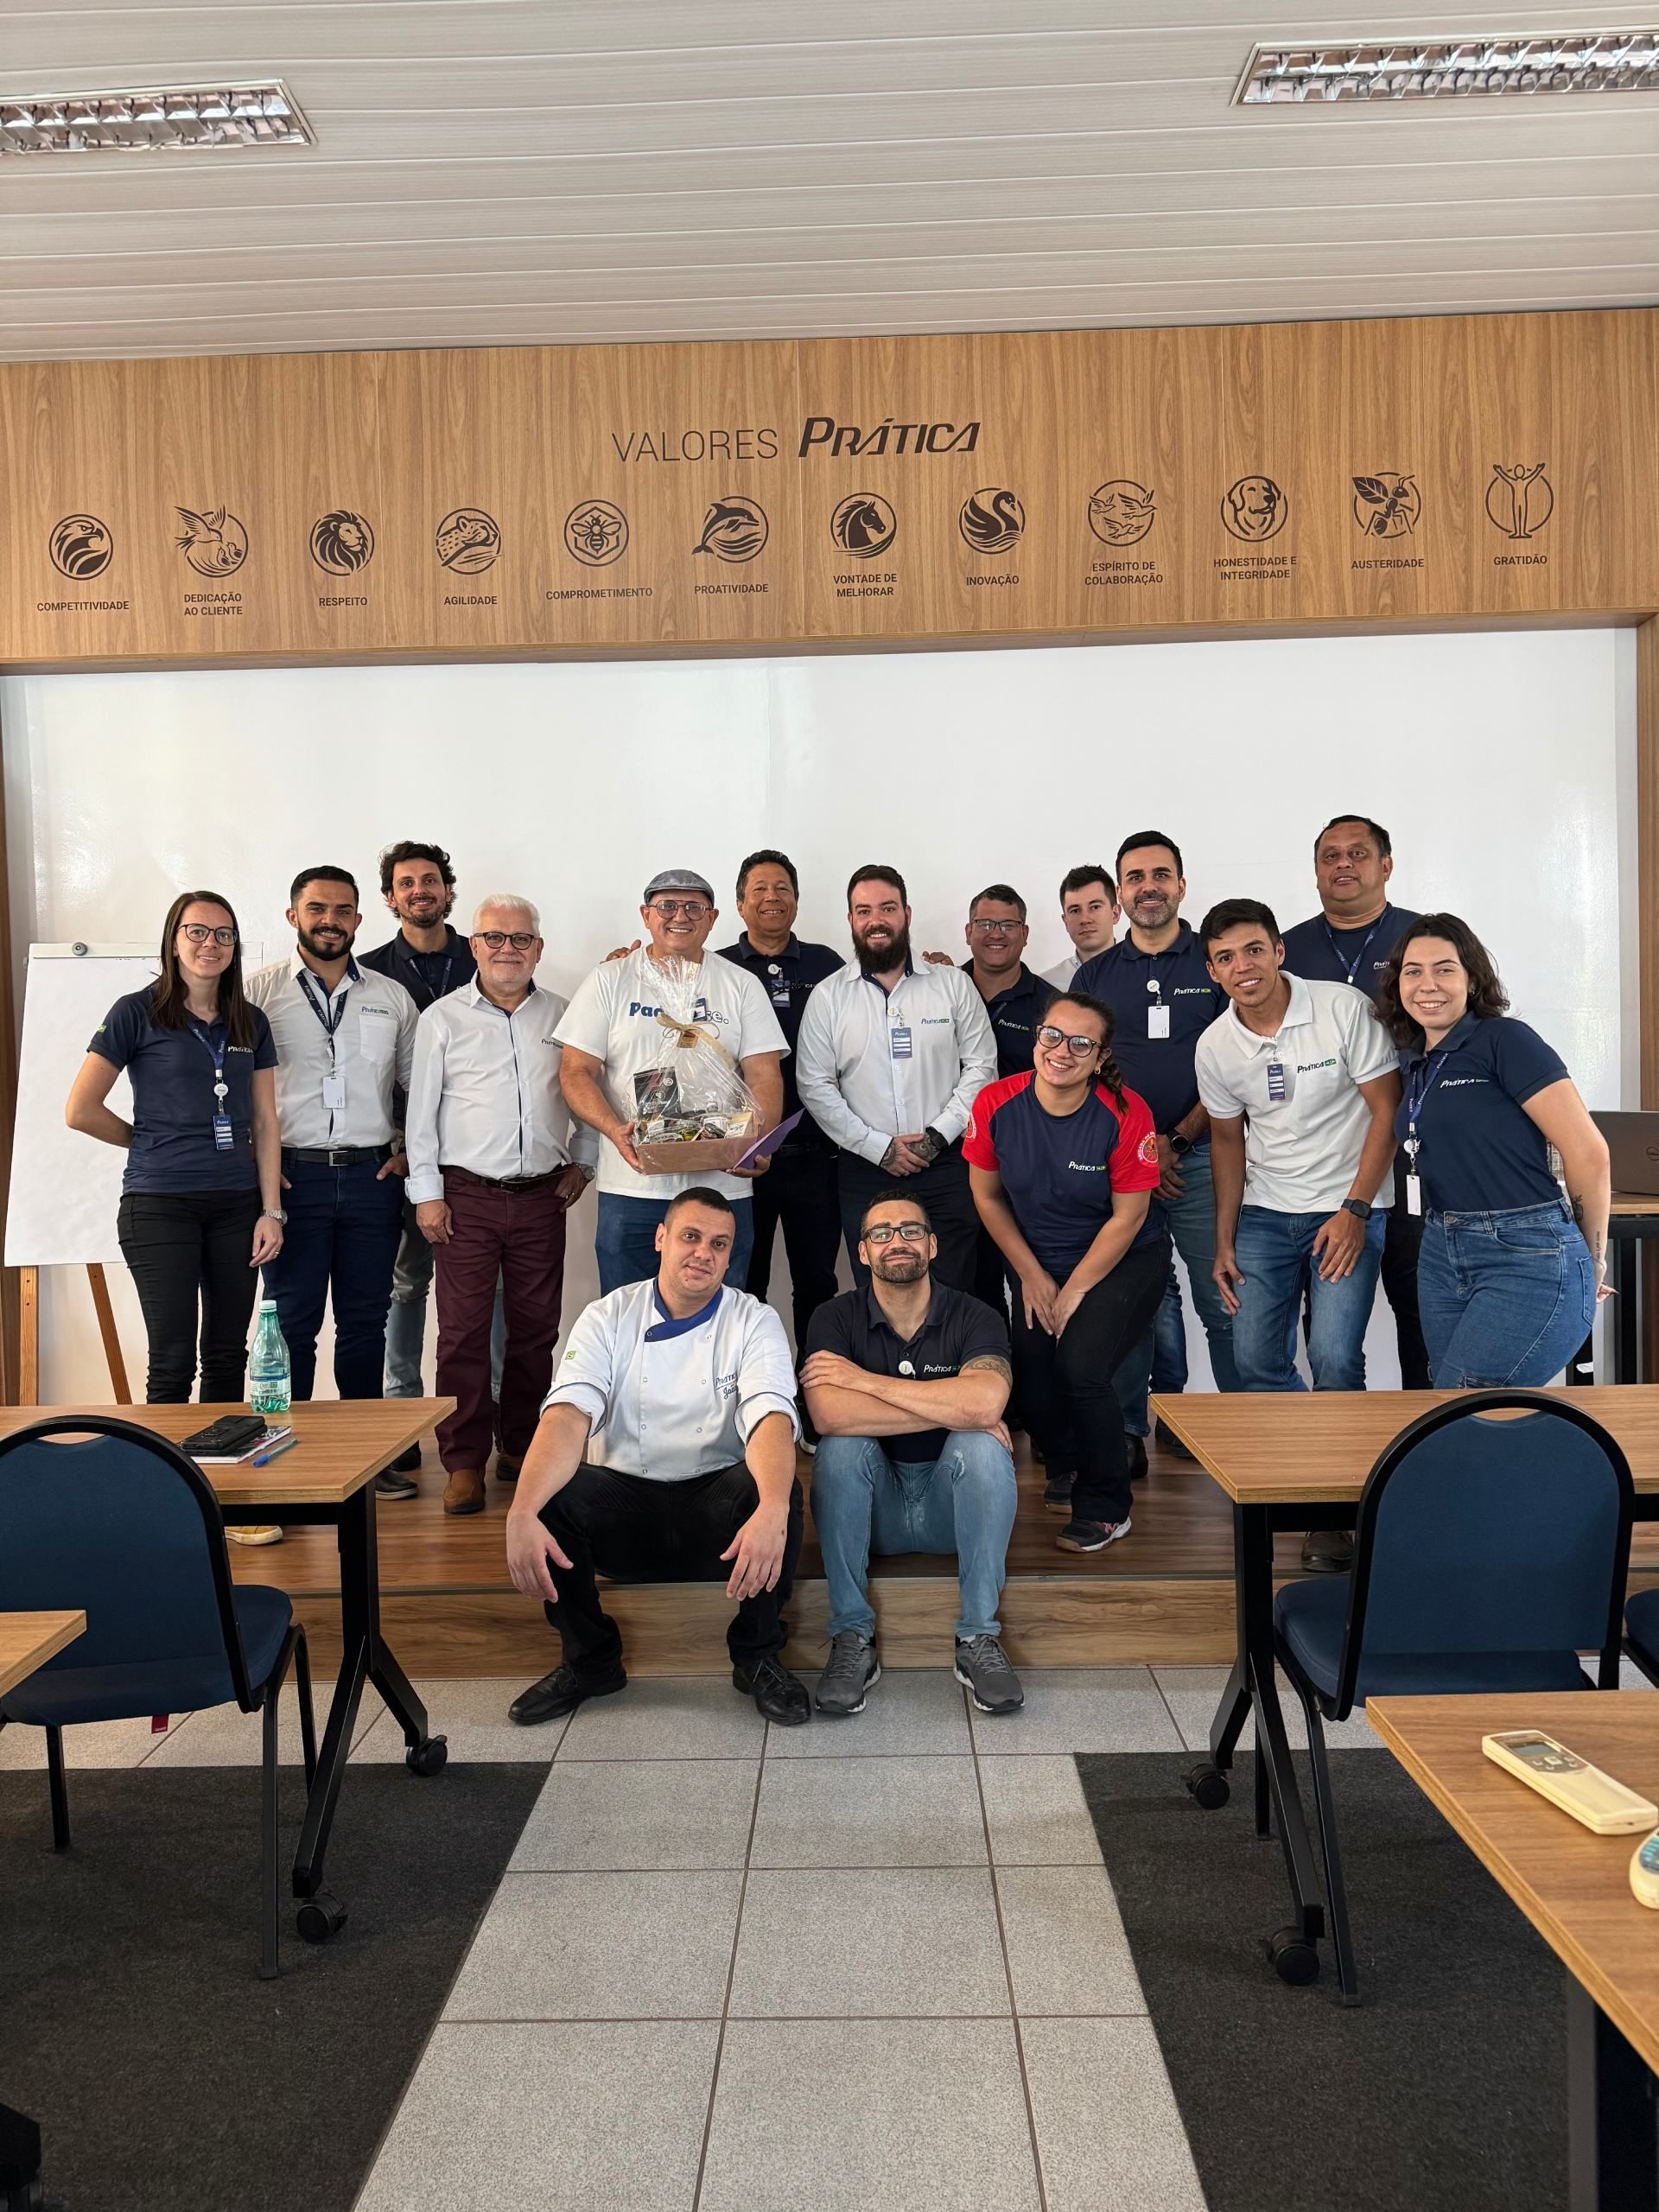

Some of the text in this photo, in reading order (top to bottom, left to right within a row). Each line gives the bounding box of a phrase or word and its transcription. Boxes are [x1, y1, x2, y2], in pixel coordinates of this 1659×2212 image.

[611, 429, 779, 463] VALORES
[1213, 556, 1298, 567] HONESTIDADE E
[1351, 558, 1425, 569] AUSTERIDADE
[1493, 553, 1548, 566] GRATIDÃO
[1092, 560, 1156, 572] ESPÍRITO DE
[833, 574, 898, 585] VONTADE DE
[966, 573, 1020, 588] INOVAÇÃO
[1084, 572, 1163, 586] COLABORAÇÃO
[1220, 569, 1291, 581] INTEGRIDADE
[545, 588, 653, 601] COMPROMETIMENTO
[694, 583, 769, 594] PROATIVIDADE
[836, 586, 894, 598] MELHORAR
[184, 591, 242, 605] DEDICAÇÃO
[318, 596, 368, 607] RESPEITO
[443, 595, 498, 606] AGILIDADE
[36, 601, 130, 612] COMPETITIVIDADE
[184, 606, 243, 616] AO CLIENTE
